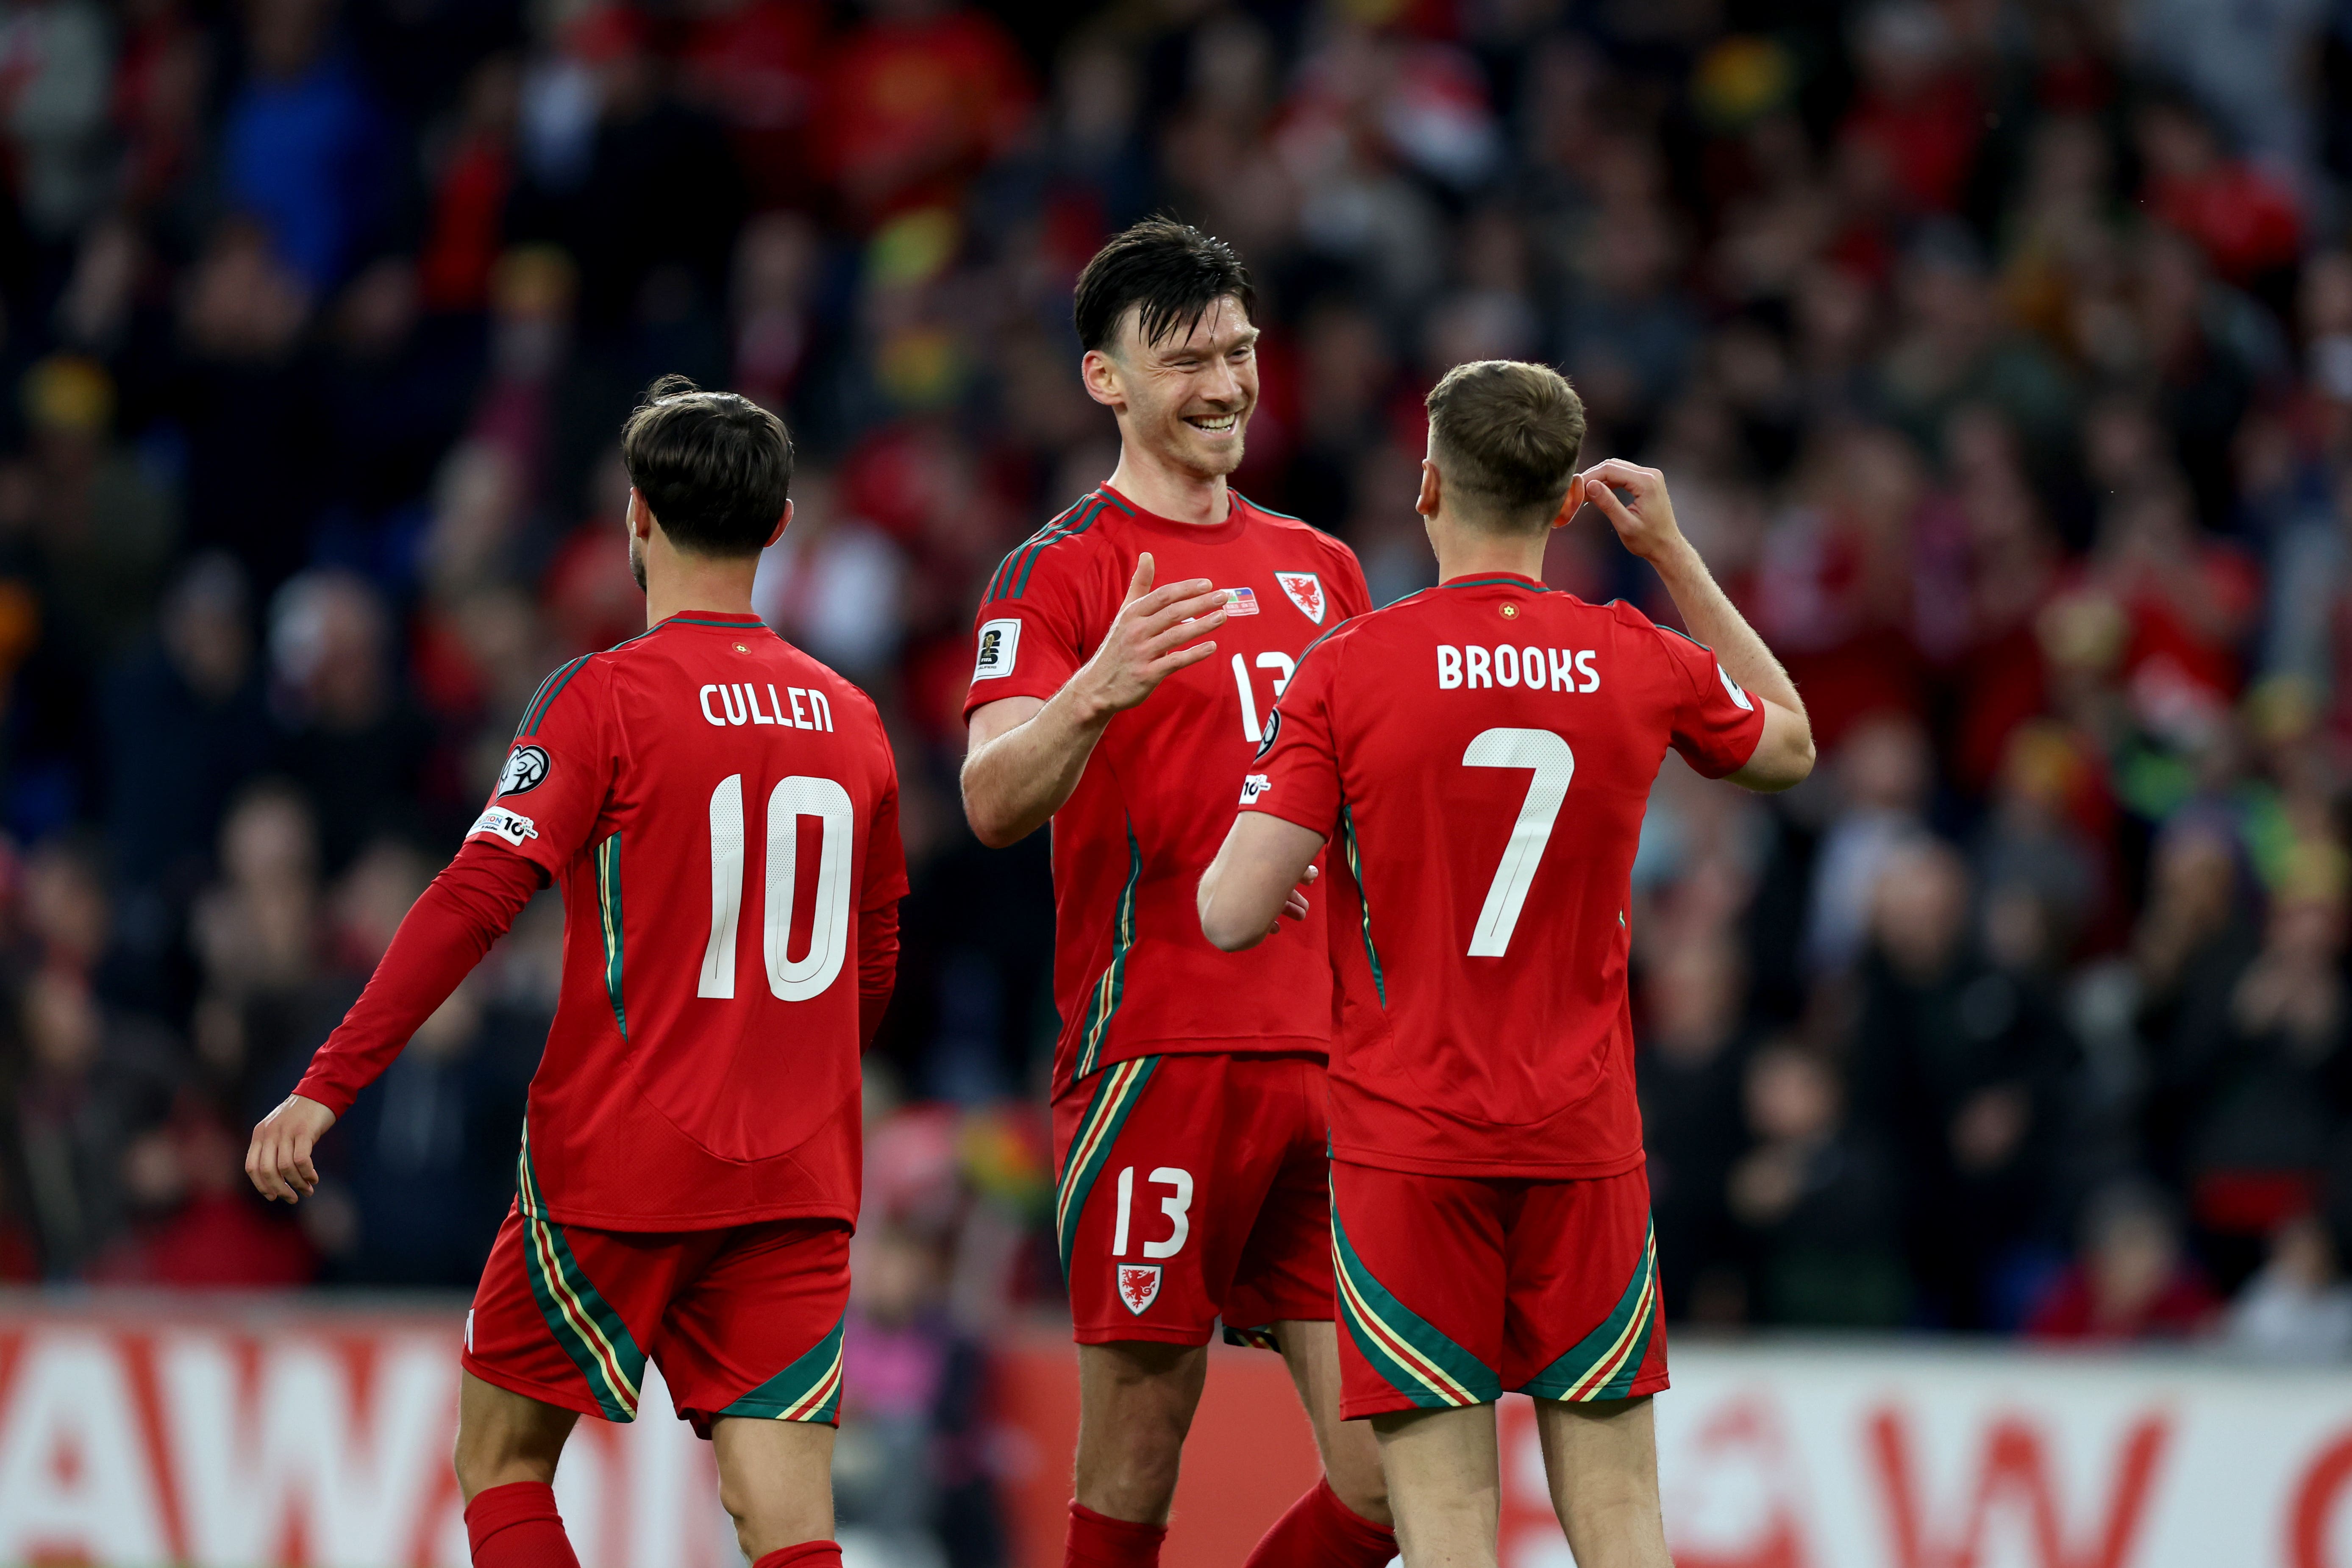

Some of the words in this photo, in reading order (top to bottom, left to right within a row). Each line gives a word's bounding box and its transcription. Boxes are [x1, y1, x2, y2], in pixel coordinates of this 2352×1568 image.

[1437, 644, 1600, 693] BROOKS
[700, 683, 834, 733] CULLEN
[1244, 782, 1259, 795] 10
[504, 817, 524, 836] 10
[1462, 727, 1574, 957] 7
[697, 773, 854, 1002] 10
[1112, 1166, 1193, 1258] 13
